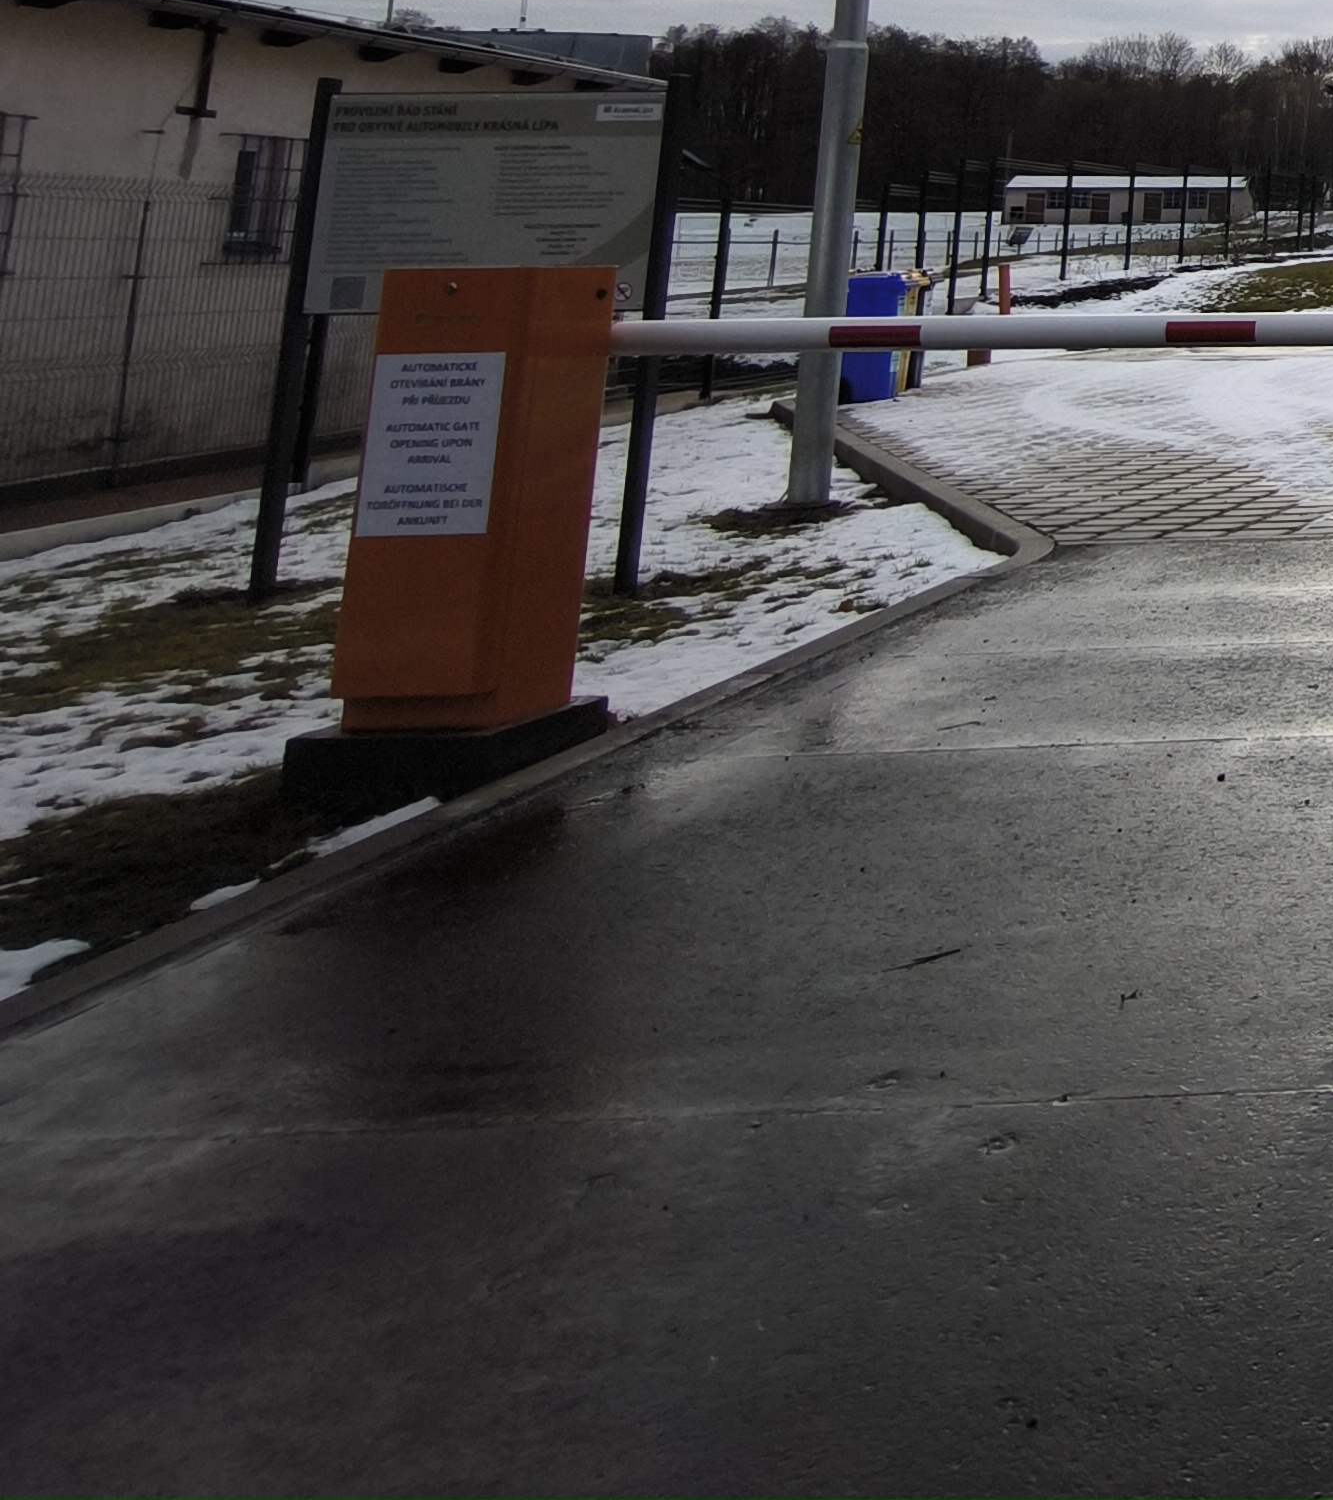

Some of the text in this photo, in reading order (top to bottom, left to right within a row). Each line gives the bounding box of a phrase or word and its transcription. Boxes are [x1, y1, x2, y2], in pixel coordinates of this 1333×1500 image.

[335, 104, 457, 116] PROVOZNÍ ŘÁD STÁNÍ
[333, 119, 558, 132] PRO OBYTNÉ AUTOMOBILY KRÁSNÁ LÍPA
[401, 361, 478, 372] AUTOMATICKÉ
[390, 376, 486, 389] OTEVÍRÁNÍ BRÁNY
[402, 393, 470, 405] PŘI PŘÍJEZDU
[386, 422, 480, 432] AUTOMATIC GATE
[390, 439, 473, 448] OPENING UPON
[408, 454, 451, 464] ARRIVAL
[384, 483, 468, 494] AUTOMATISCHE
[367, 498, 483, 510] TORÖFFNUNG BEI DER
[397, 516, 447, 526] ANKUNFT
